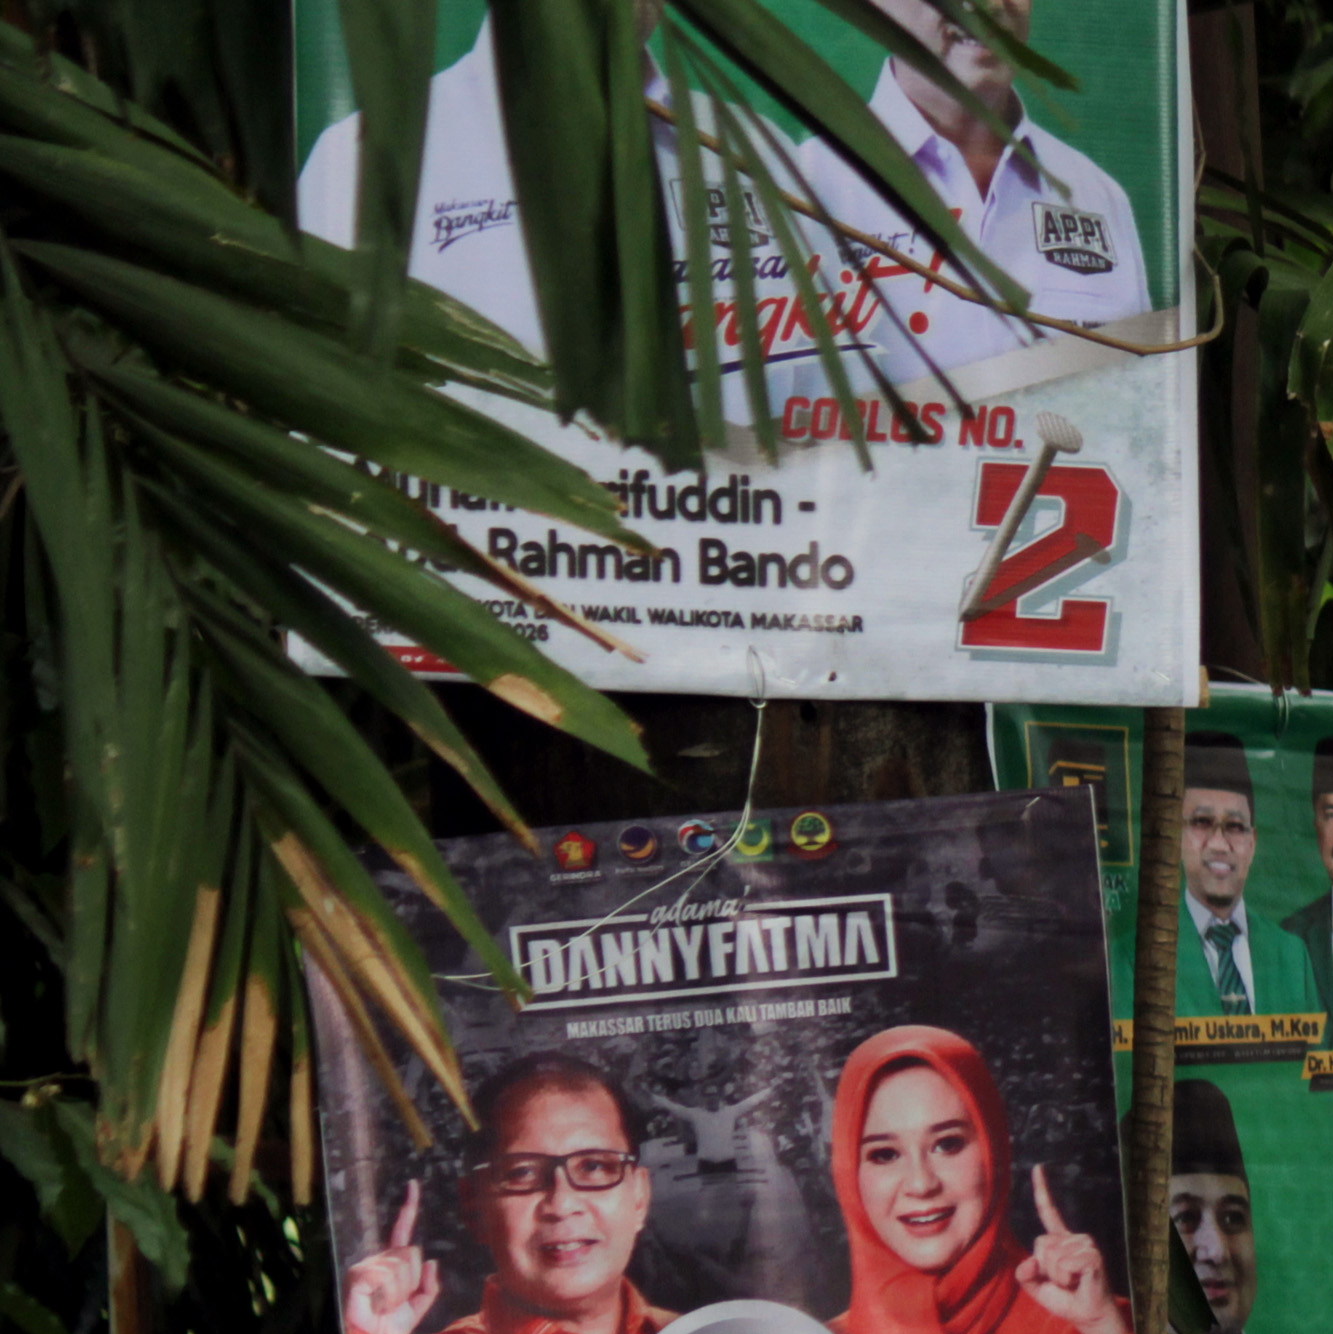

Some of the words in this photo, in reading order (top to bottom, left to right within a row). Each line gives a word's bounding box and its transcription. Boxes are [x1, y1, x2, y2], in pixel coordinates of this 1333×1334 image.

[1042, 209, 1111, 252] APPI
[1052, 251, 1107, 270] RAHMAN
[958, 405, 1024, 449] NO.
[488, 527, 682, 583] Rahman
[699, 538, 855, 589] Bando
[957, 456, 1120, 653] 2
[582, 604, 642, 624] WAKIL
[646, 607, 745, 629] WALIKOTA
[750, 612, 864, 633] MAKASSAR
[566, 1015, 644, 1040] MAKASSAR
[648, 1011, 692, 1032] TERUS
[695, 1008, 724, 1027] DUA
[726, 1005, 758, 1025] KALI
[758, 1000, 815, 1022] TAMBAH
[818, 997, 852, 1017] BAIK
[1205, 1019, 1267, 1041] Uskara,
[1271, 1016, 1320, 1039] M.Kes
